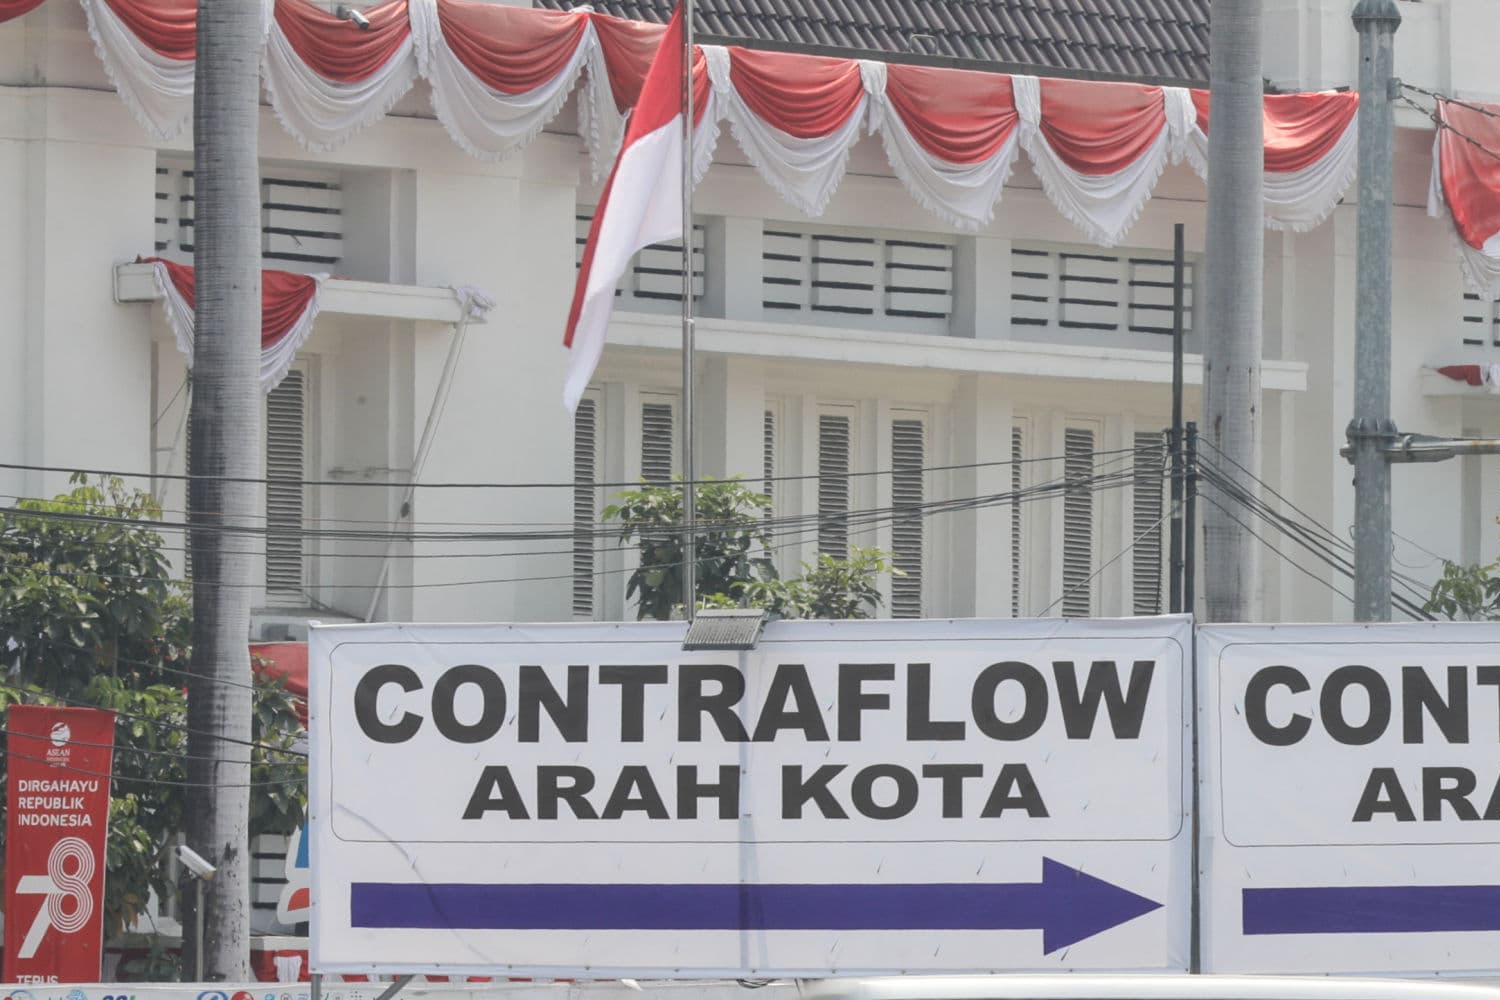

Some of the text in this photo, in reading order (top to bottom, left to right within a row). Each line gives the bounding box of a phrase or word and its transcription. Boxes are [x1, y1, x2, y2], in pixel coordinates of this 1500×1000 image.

[353, 660, 1156, 744] CONTRAFLOW
[18, 780, 98, 793] DIRGAHAYU
[18, 797, 84, 810] REPUBLIK
[462, 763, 1050, 821] ARAH KOTA
[18, 814, 92, 827] INDONESIA
[15, 837, 95, 958] 78
